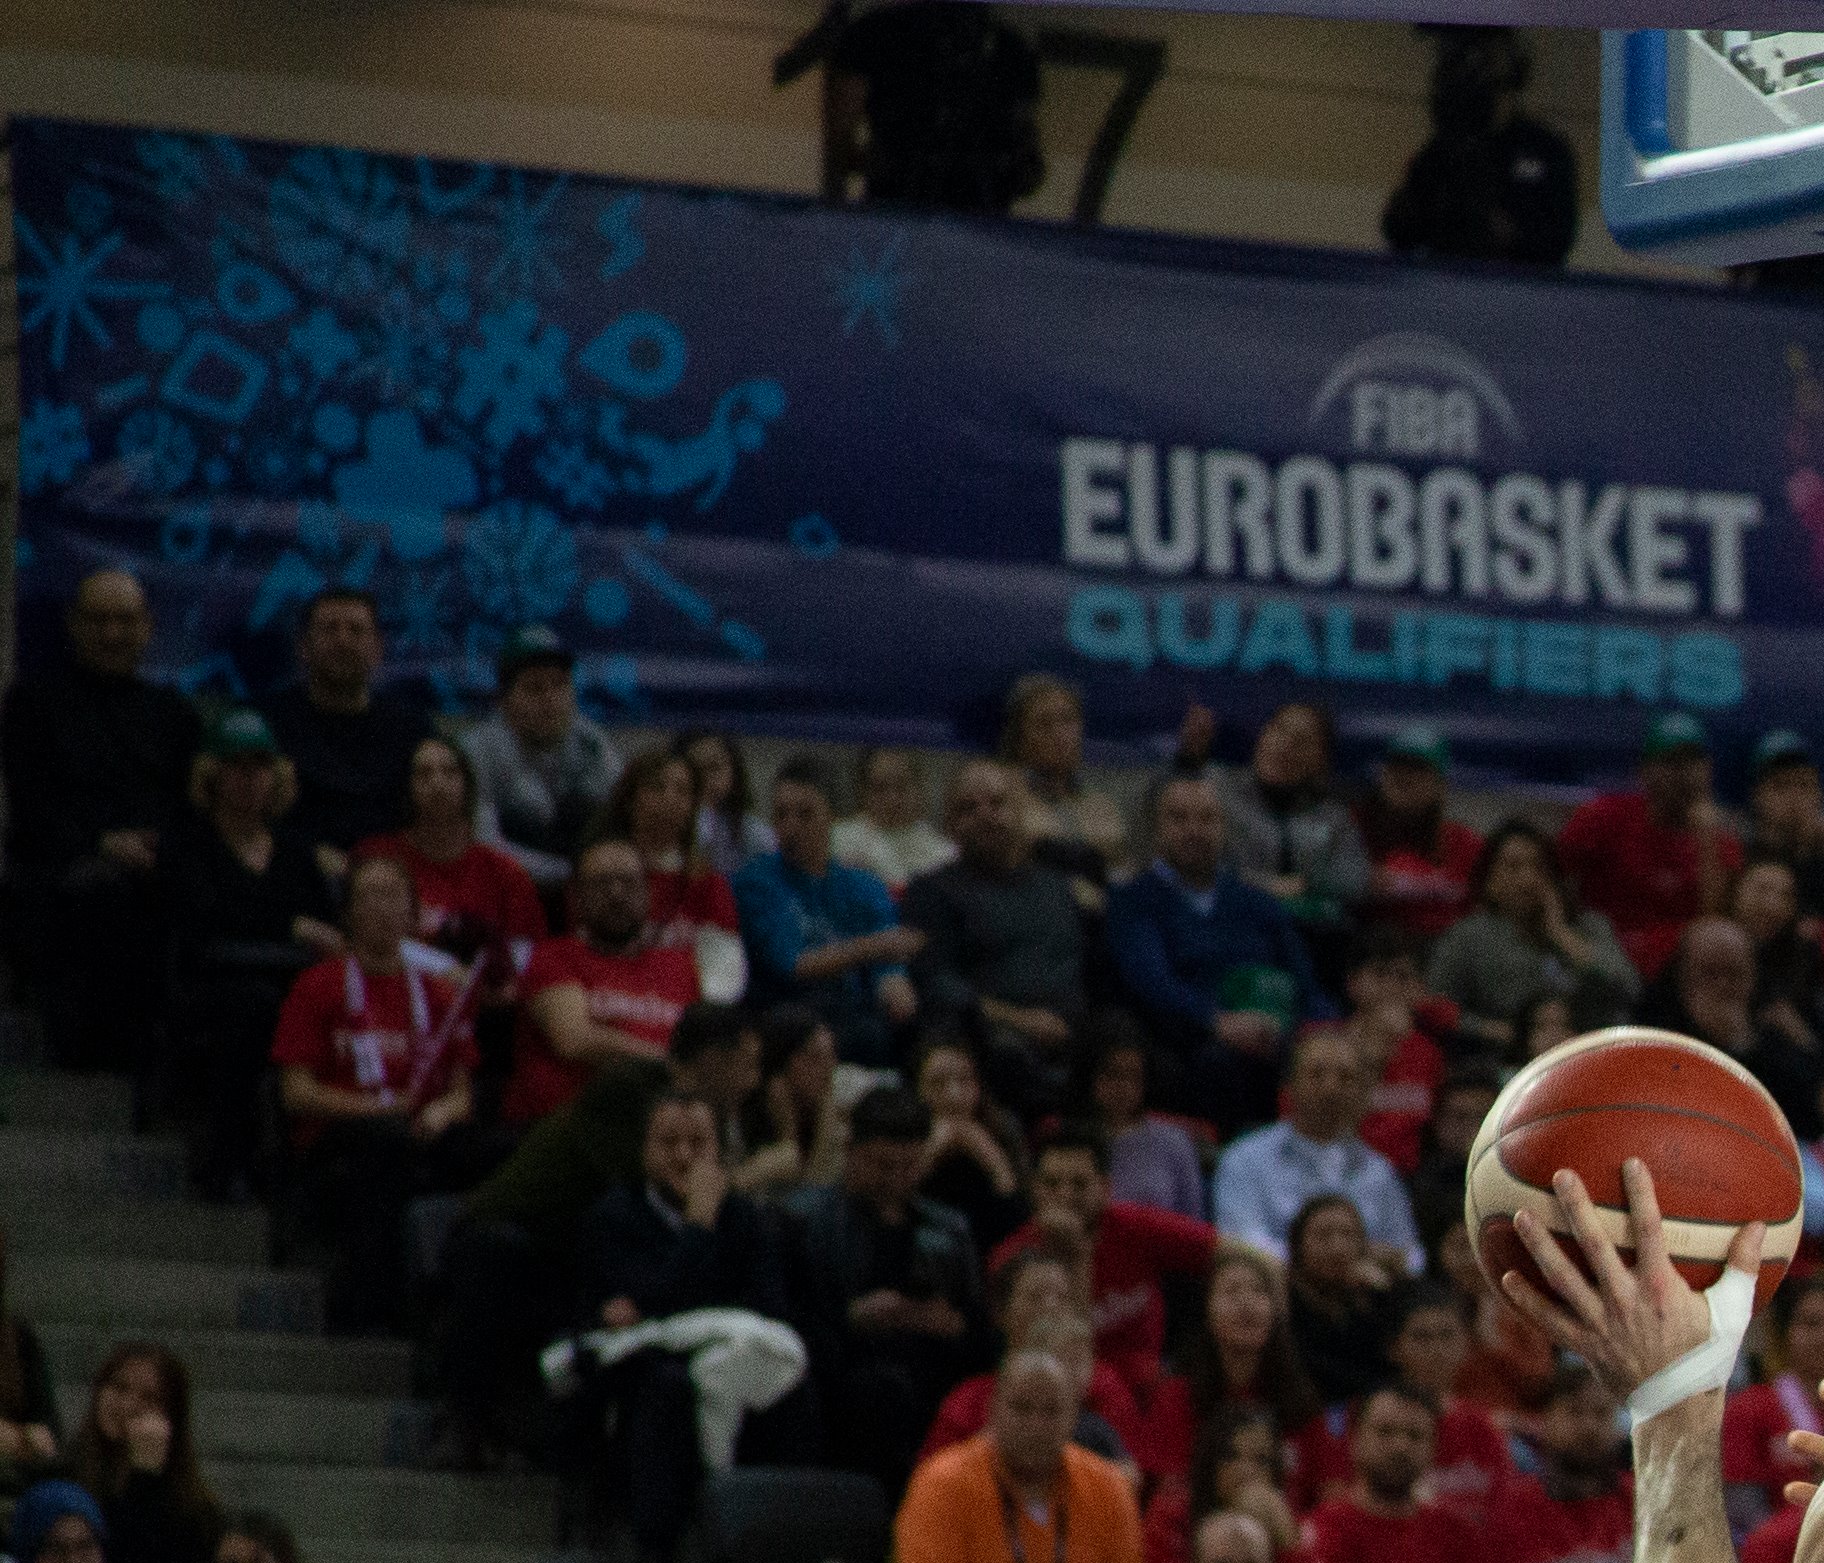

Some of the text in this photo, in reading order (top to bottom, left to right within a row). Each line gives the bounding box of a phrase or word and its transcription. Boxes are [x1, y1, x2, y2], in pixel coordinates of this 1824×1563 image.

[1350, 382, 1479, 456] FIBA
[1061, 438, 1761, 614] EUROBASKET
[1066, 585, 1745, 708] QUALIFIERS
